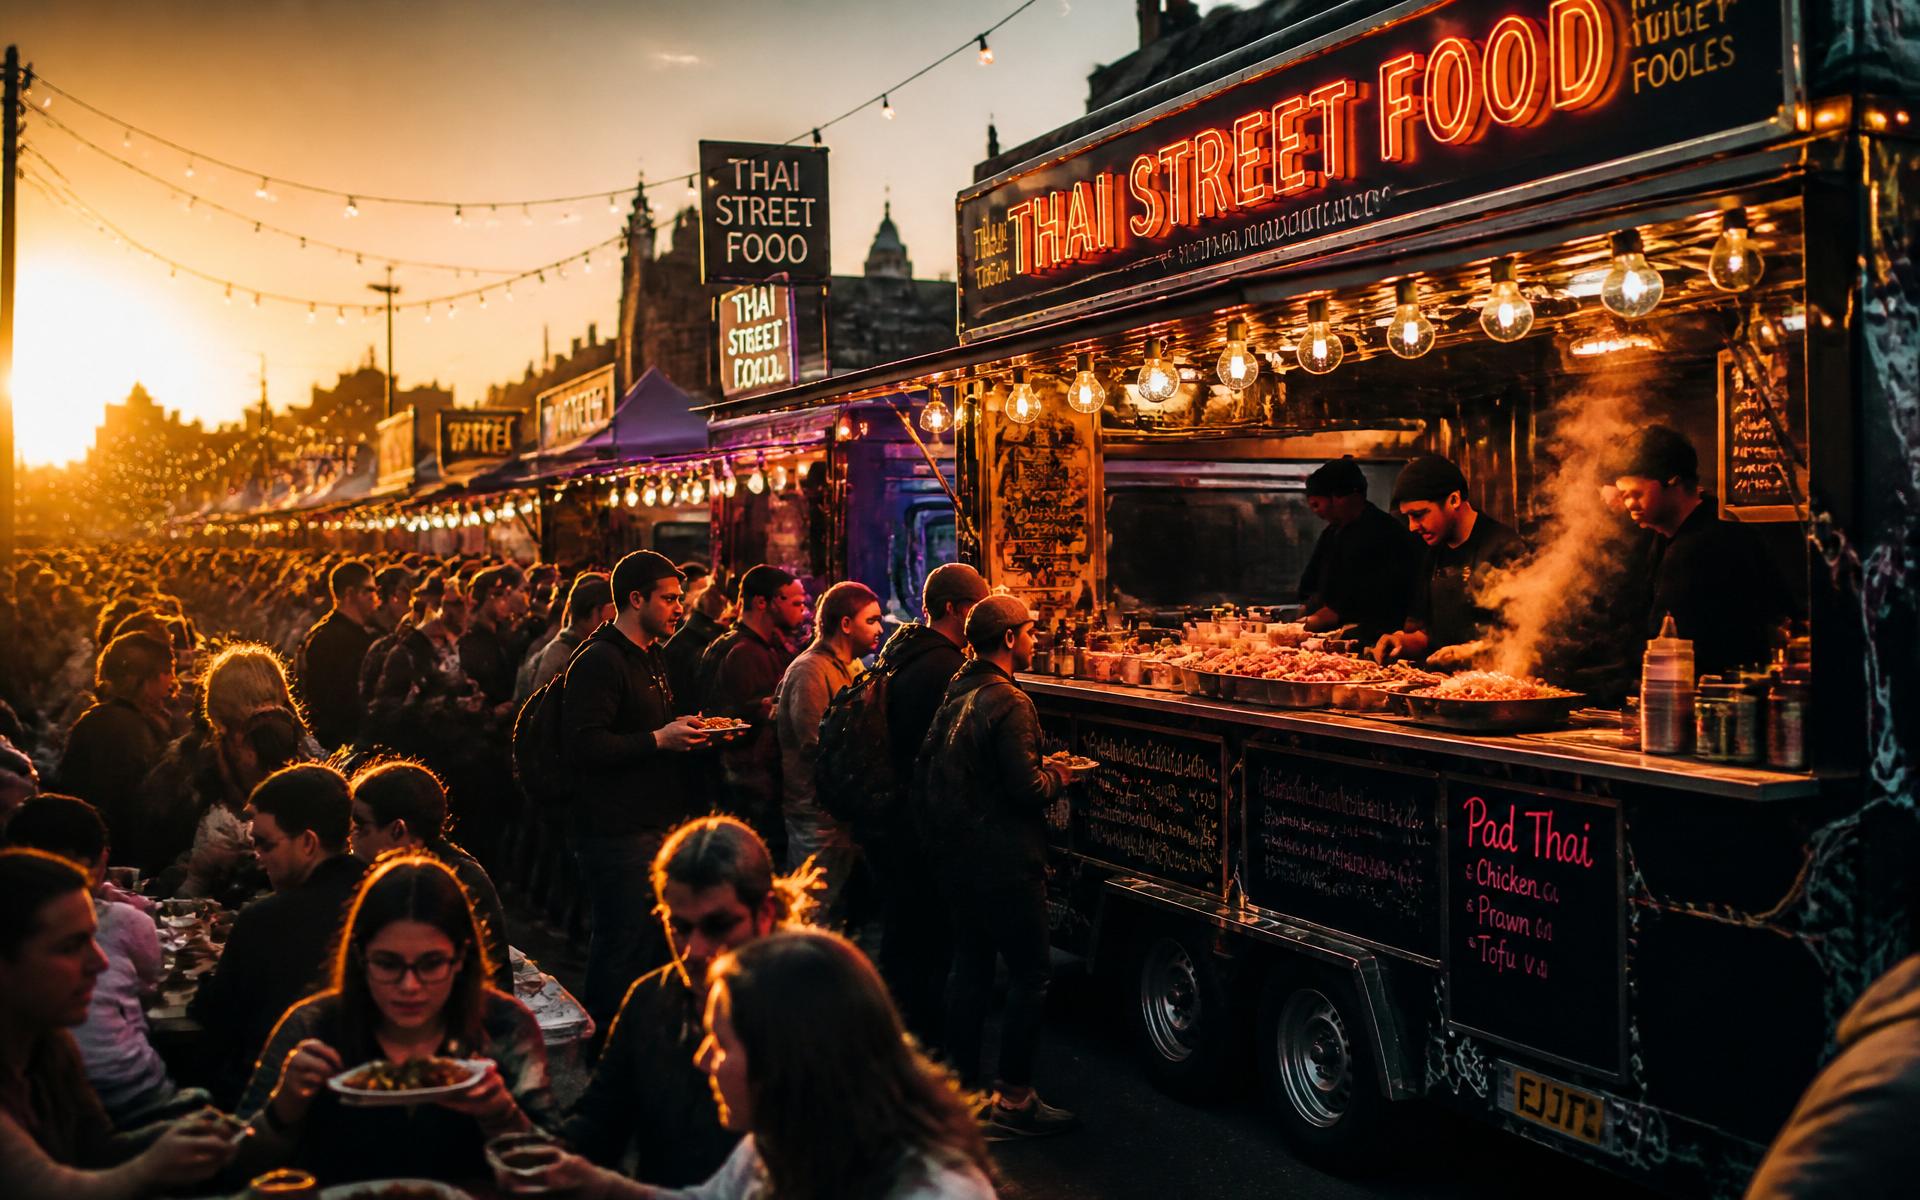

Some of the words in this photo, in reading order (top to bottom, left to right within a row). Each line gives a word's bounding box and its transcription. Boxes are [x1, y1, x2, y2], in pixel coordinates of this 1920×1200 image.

[1008, 172, 1114, 275] THAI
[1130, 79, 1354, 238] STREET
[1379, 0, 1612, 161] FOOD
[727, 157, 799, 192] THAI
[716, 194, 816, 228] STREET
[731, 284, 776, 323] THAI
[1463, 796, 1518, 852] Pad
[1525, 810, 1593, 867] Thai
[1477, 858, 1540, 899] Chicken
[1479, 895, 1530, 936] Prawn
[1478, 935, 1516, 973] Tofu
